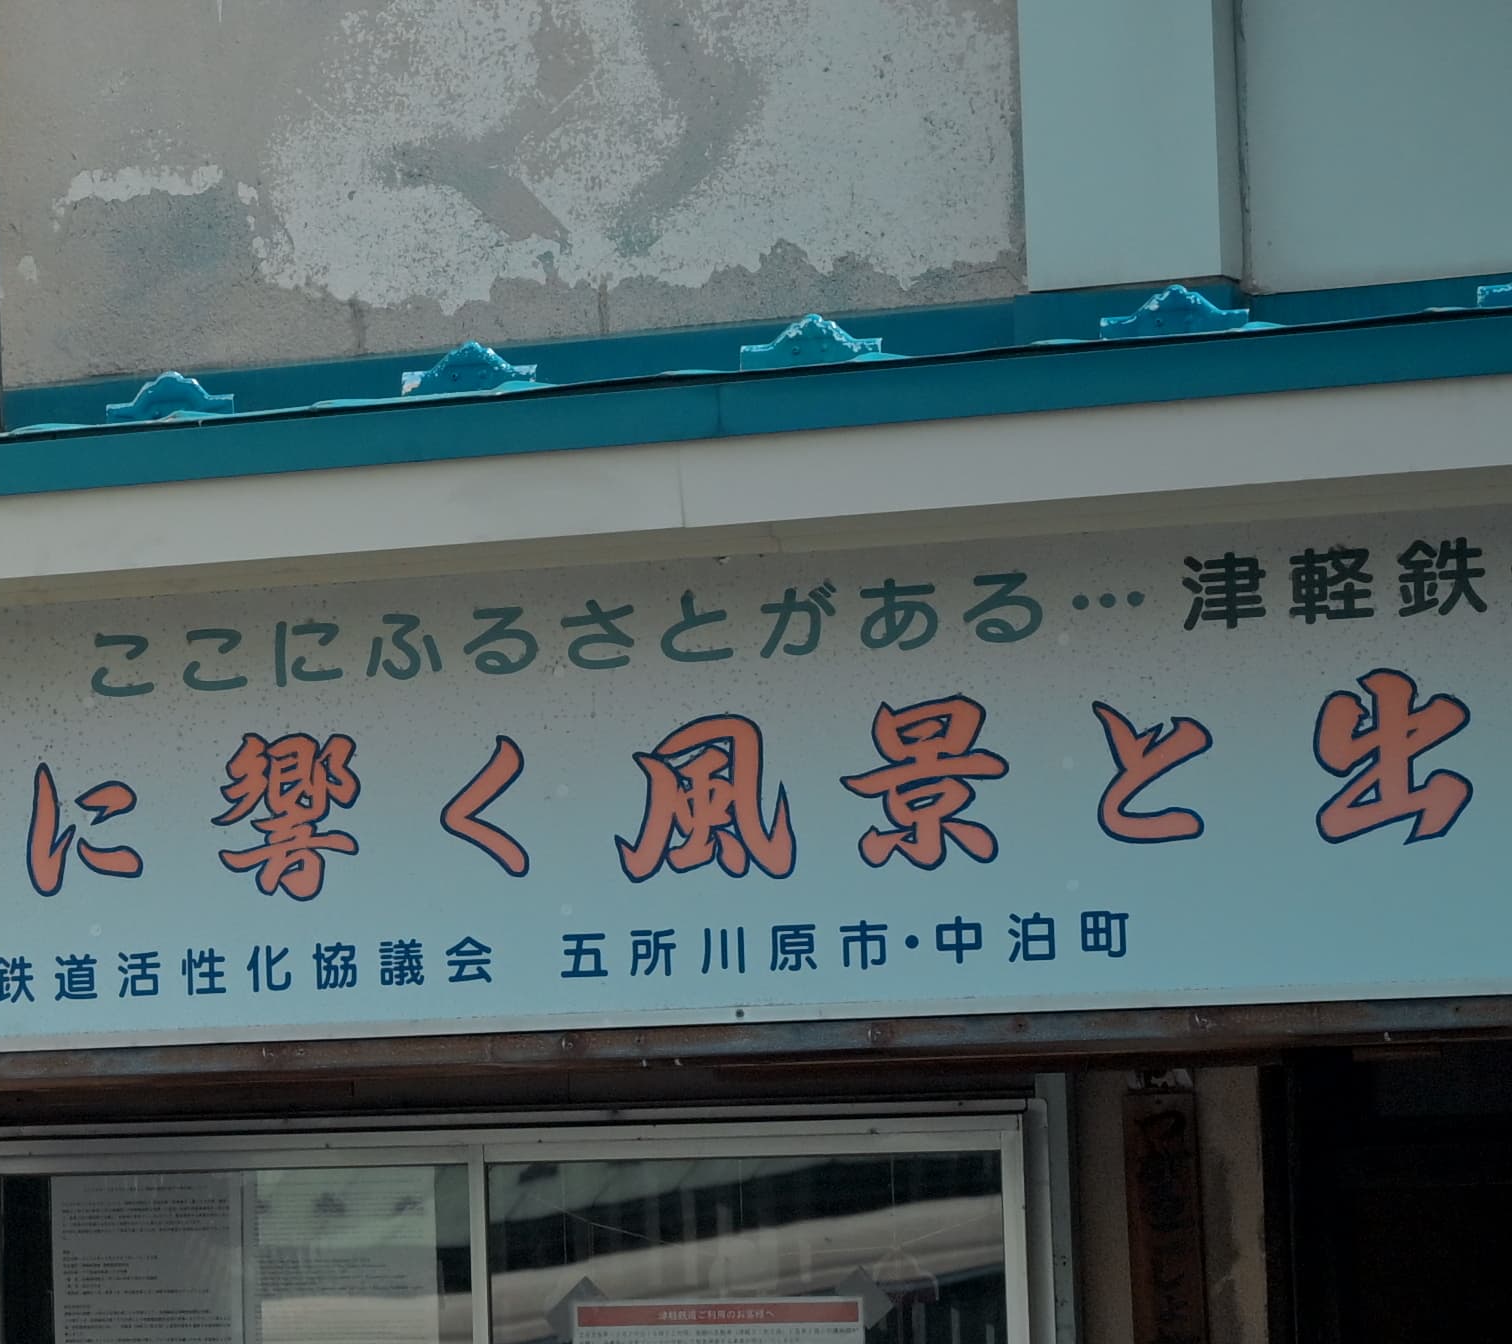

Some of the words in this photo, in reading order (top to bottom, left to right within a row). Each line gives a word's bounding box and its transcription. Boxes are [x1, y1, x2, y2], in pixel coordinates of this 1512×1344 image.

[560, 908, 1130, 981] 五所川原市・中泊町
